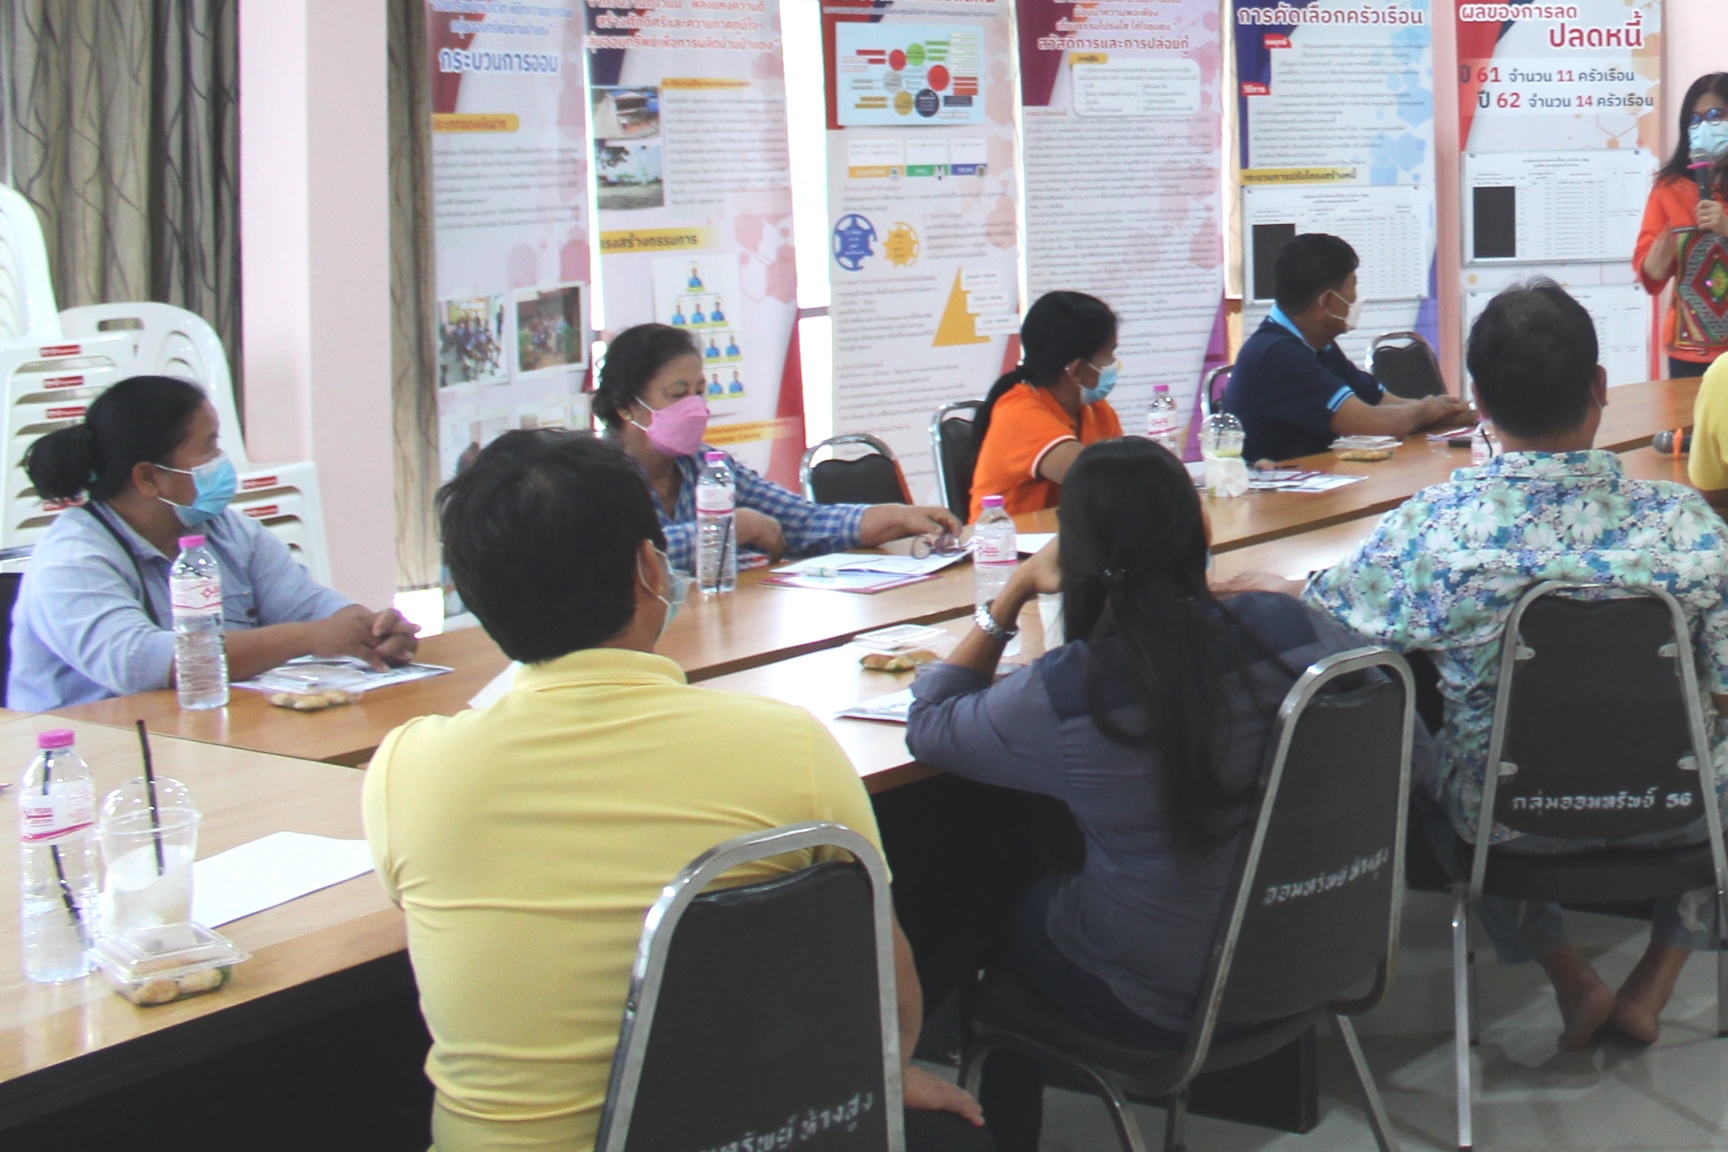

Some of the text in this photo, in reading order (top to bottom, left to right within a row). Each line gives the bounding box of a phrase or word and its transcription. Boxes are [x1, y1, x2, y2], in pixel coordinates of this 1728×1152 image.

[1238, 3, 1423, 25] การคัดเลือกครัวเรือน
[1462, 5, 1577, 20] ผลของการลด
[1550, 11, 1643, 47] ปลดหนี้
[440, 50, 558, 73] กระบวนการออม
[1460, 65, 1635, 83] ปี 61 จำนวน 11 ครัวเรือน
[1478, 89, 1654, 109] ปี 62 จำนวน 14 ครัวเรือน
[1512, 786, 1659, 816] กลุ่มออมทรัพย์
